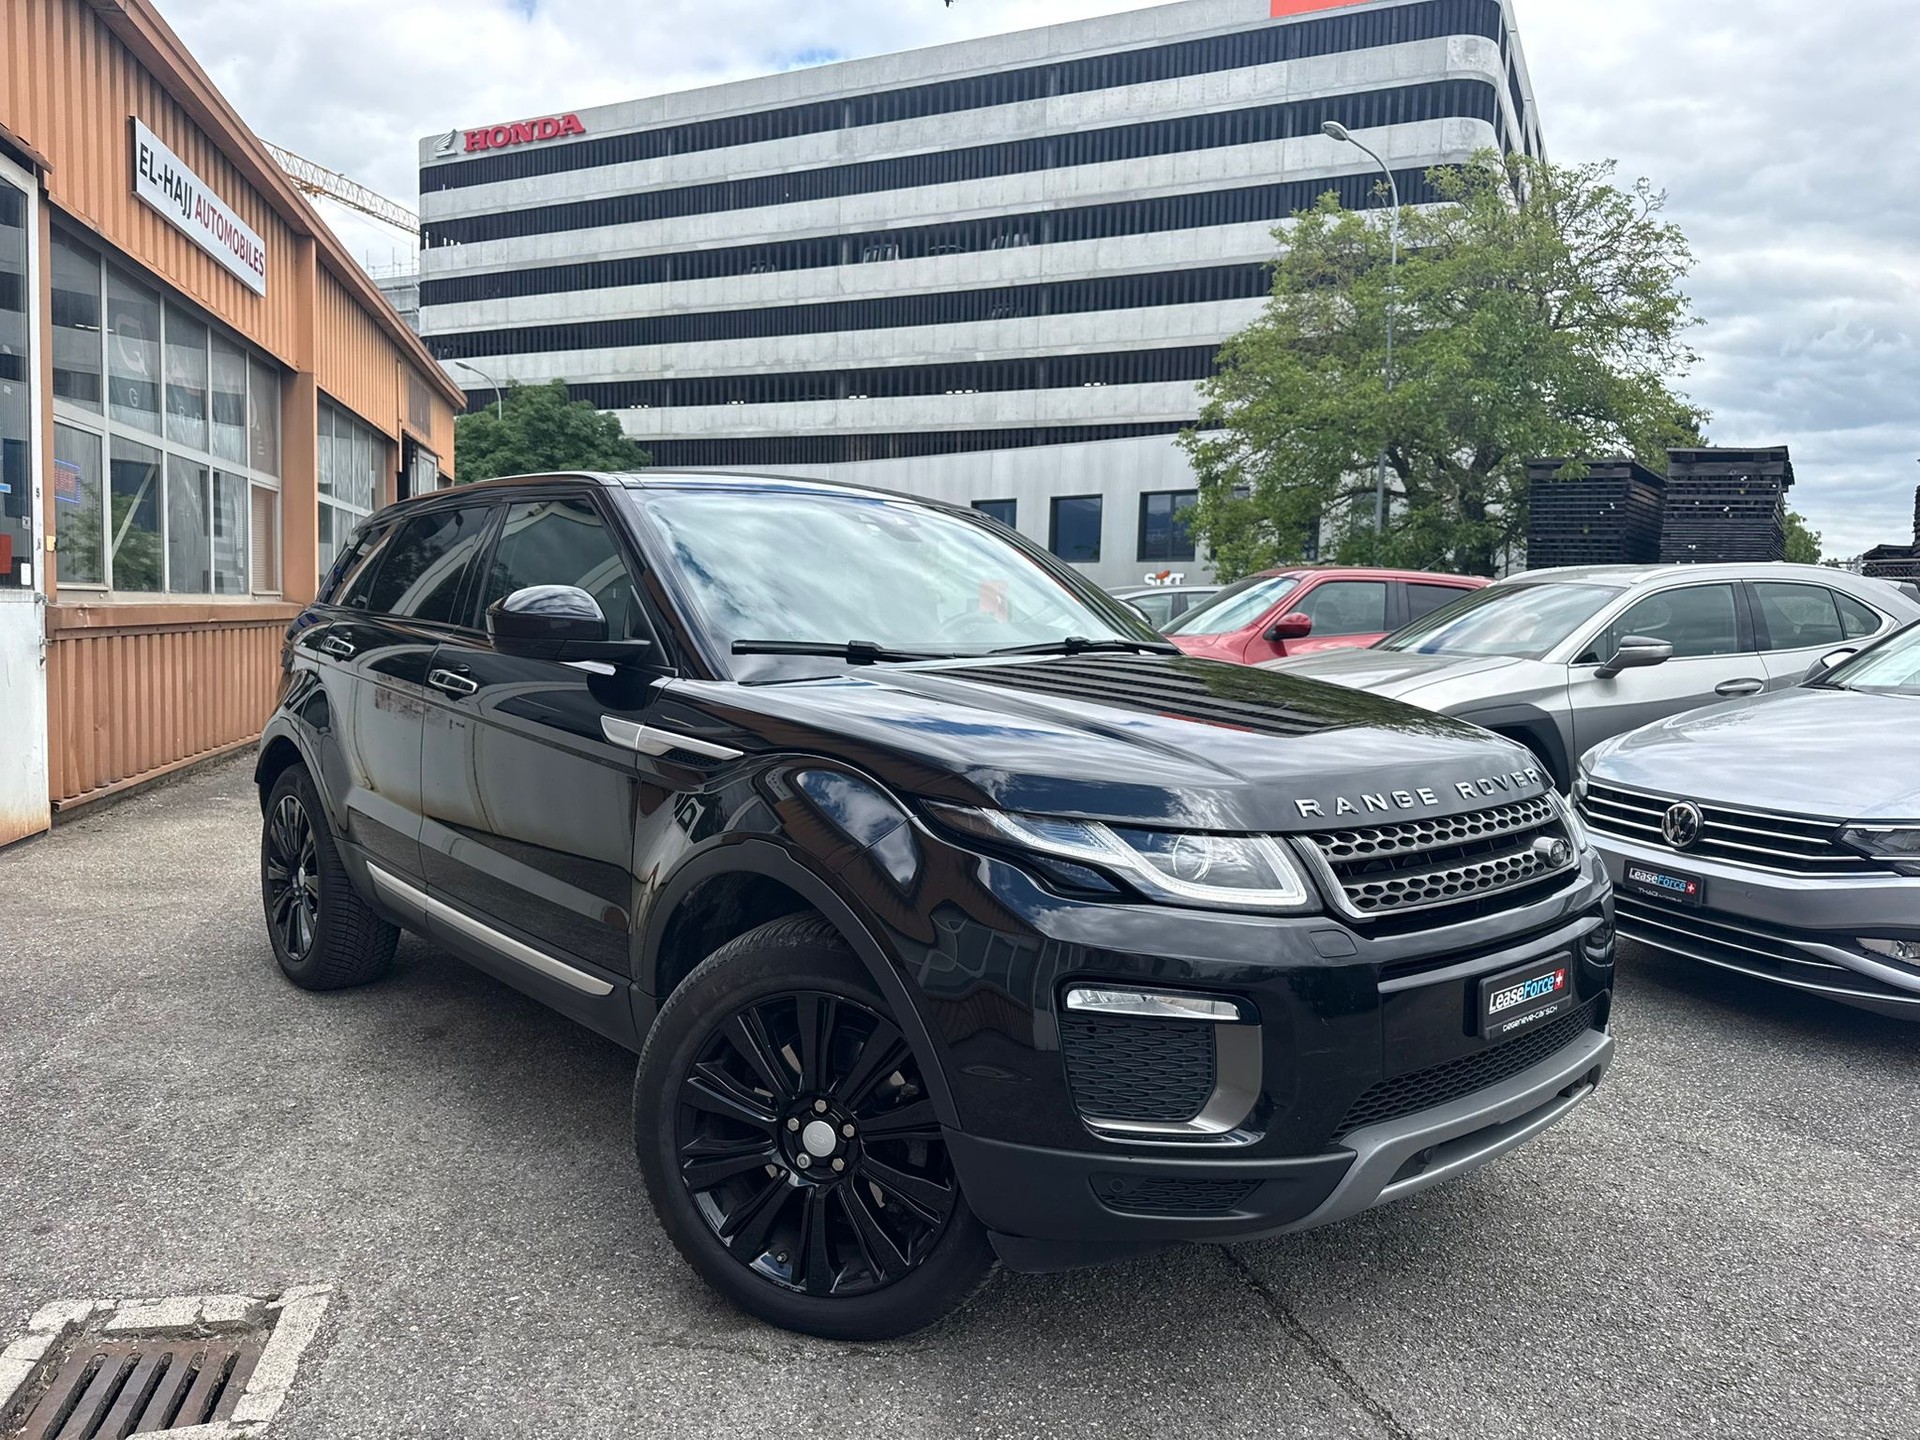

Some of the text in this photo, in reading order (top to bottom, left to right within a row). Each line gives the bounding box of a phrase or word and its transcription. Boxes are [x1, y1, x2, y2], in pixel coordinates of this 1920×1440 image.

[464, 114, 586, 153] HONDA
[139, 142, 264, 277] EL-HAJJ AUTOMOBILES
[1294, 767, 1541, 818] RANGE ROVER
[1629, 867, 1686, 890] LeaseForce
[1489, 975, 1555, 1013] LeaseForce
